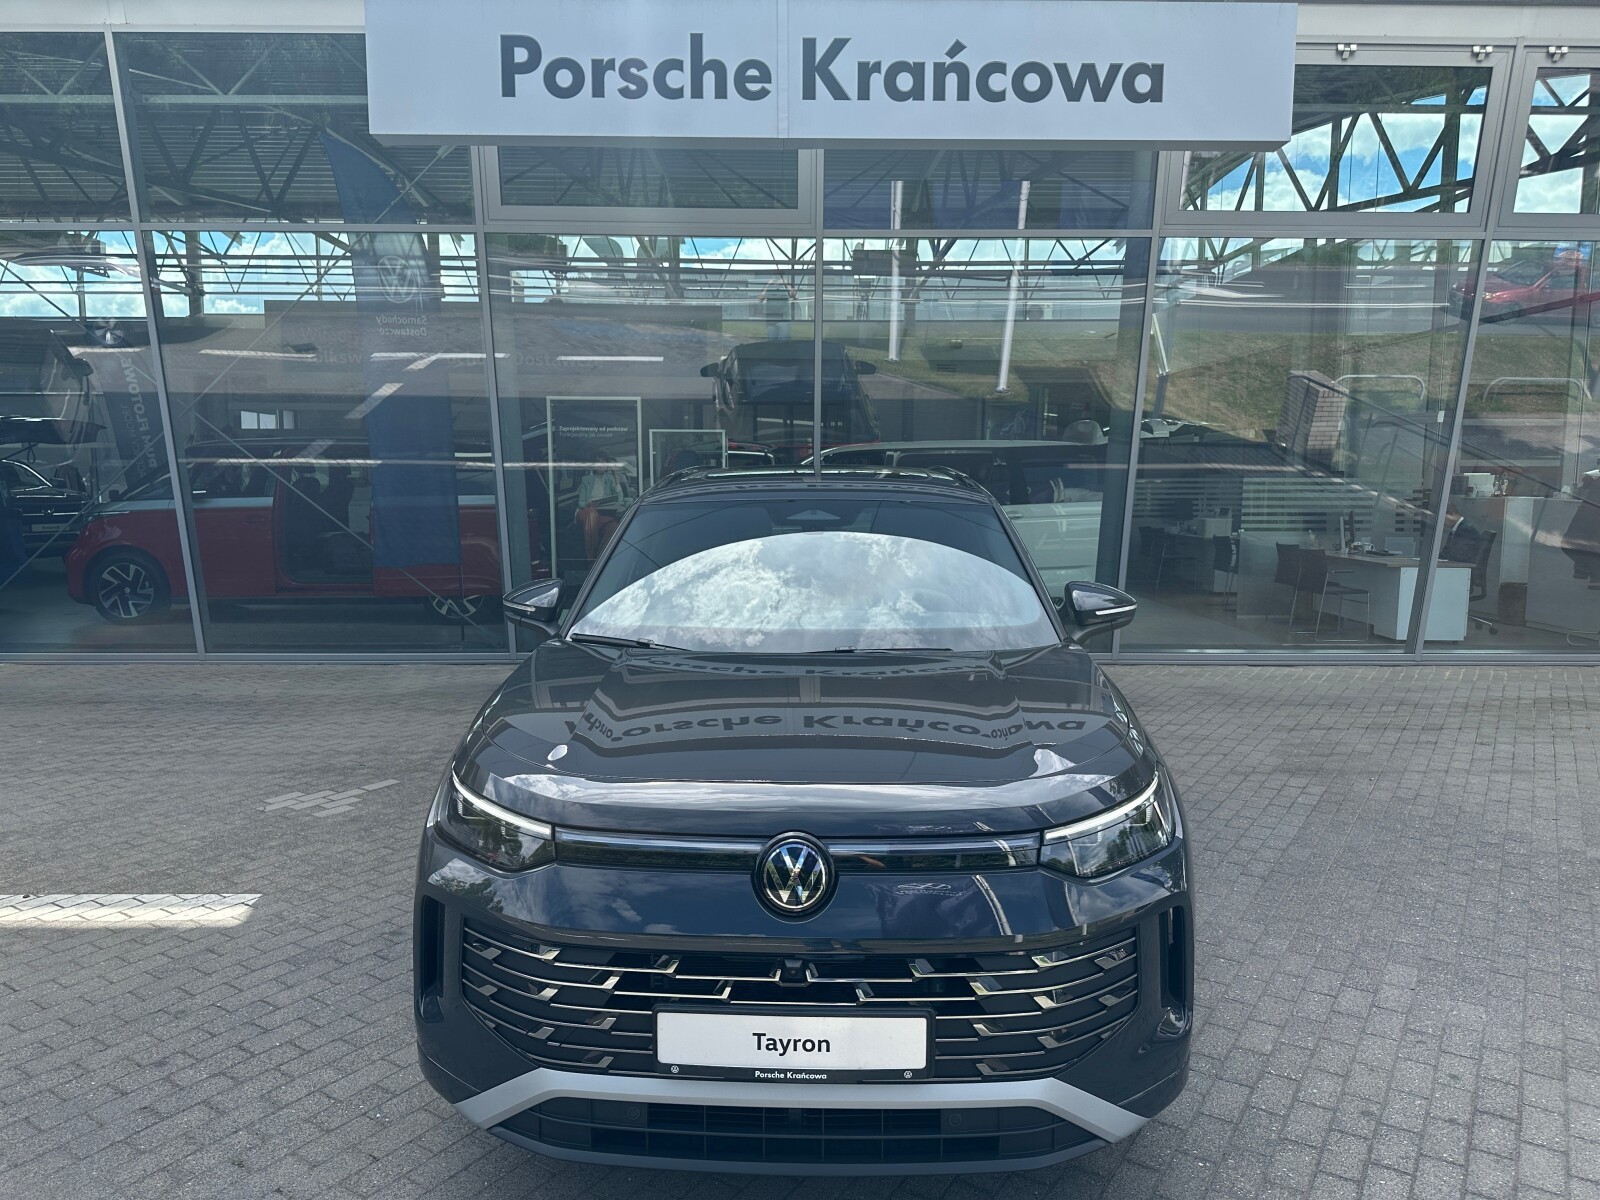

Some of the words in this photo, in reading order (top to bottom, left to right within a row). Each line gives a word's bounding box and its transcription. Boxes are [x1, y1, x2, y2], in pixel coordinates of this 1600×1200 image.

[499, 32, 772, 101] Porsche
[801, 37, 1165, 103] Krańcowa
[752, 1032, 831, 1056] Tayron
[754, 1070, 785, 1079] Porsche
[786, 1071, 828, 1080] Krańcowa
